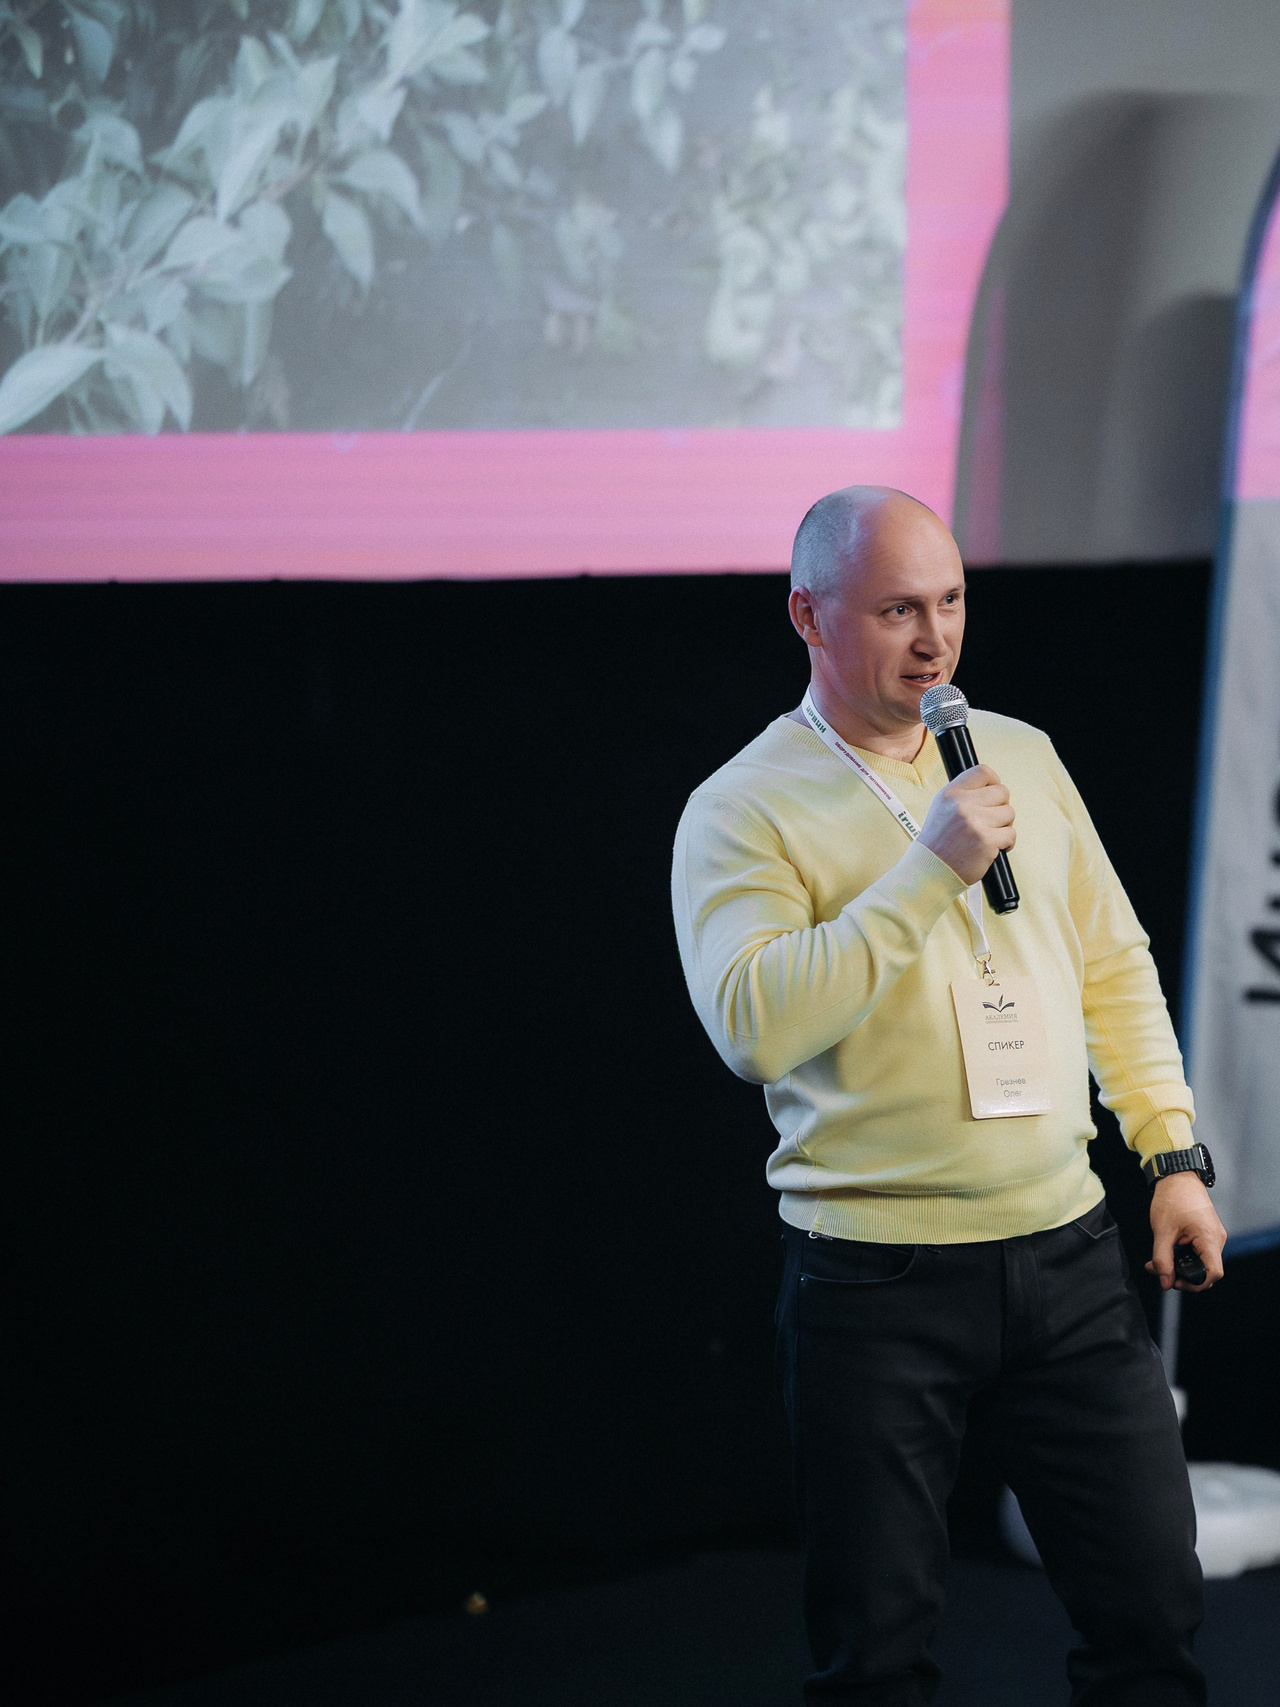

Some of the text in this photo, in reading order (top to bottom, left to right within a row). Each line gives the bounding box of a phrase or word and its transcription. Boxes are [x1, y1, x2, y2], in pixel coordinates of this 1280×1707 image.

[898, 811, 921, 838] irwi
[985, 1013, 1018, 1021] АКАДЕМИЯ
[988, 1040, 1025, 1051] СПИКЕР
